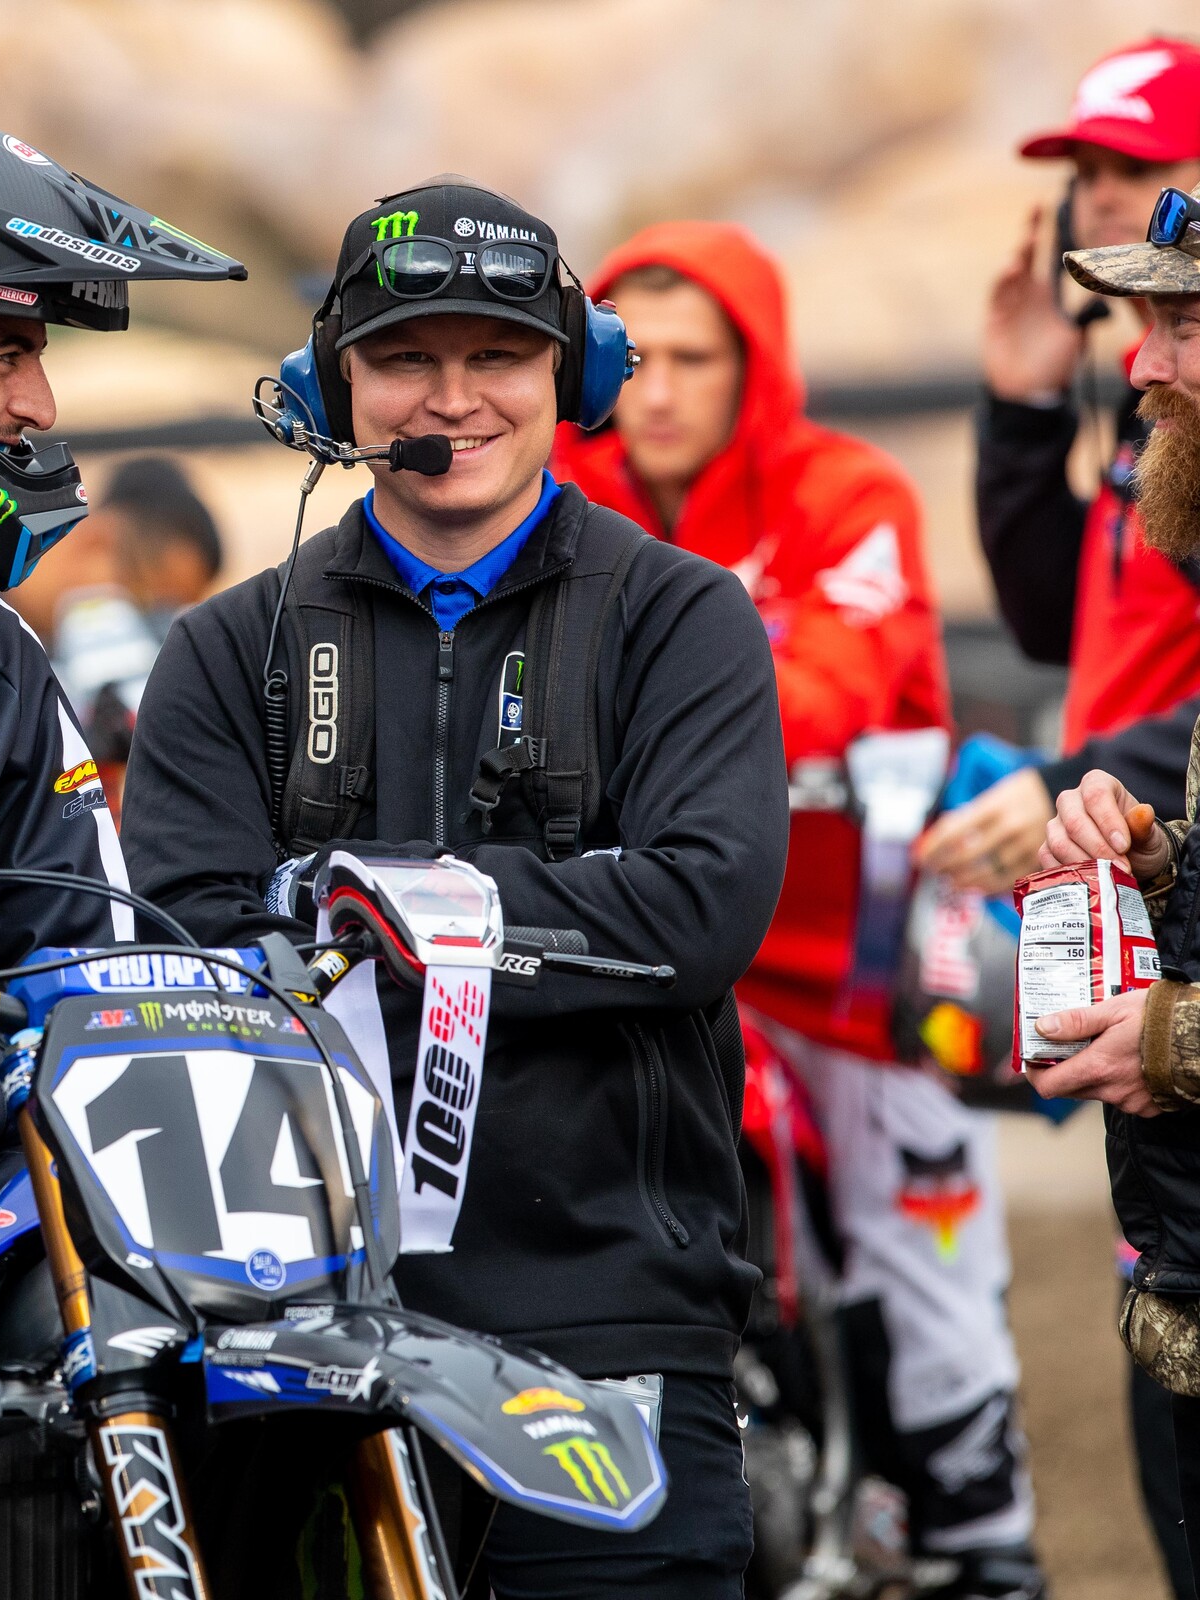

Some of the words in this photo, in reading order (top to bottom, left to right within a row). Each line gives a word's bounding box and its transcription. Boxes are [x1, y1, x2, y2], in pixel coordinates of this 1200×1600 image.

[6, 217, 141, 273] apdesigns
[476, 220, 538, 242] YAMAHA
[308, 643, 339, 764] OGIO
[1025, 922, 1060, 931] Nutrition
[1067, 949, 1085, 958] 150
[186, 1023, 264, 1038] ENERGY
[411, 976, 484, 1200] 100%
[85, 1055, 348, 1258] 14
